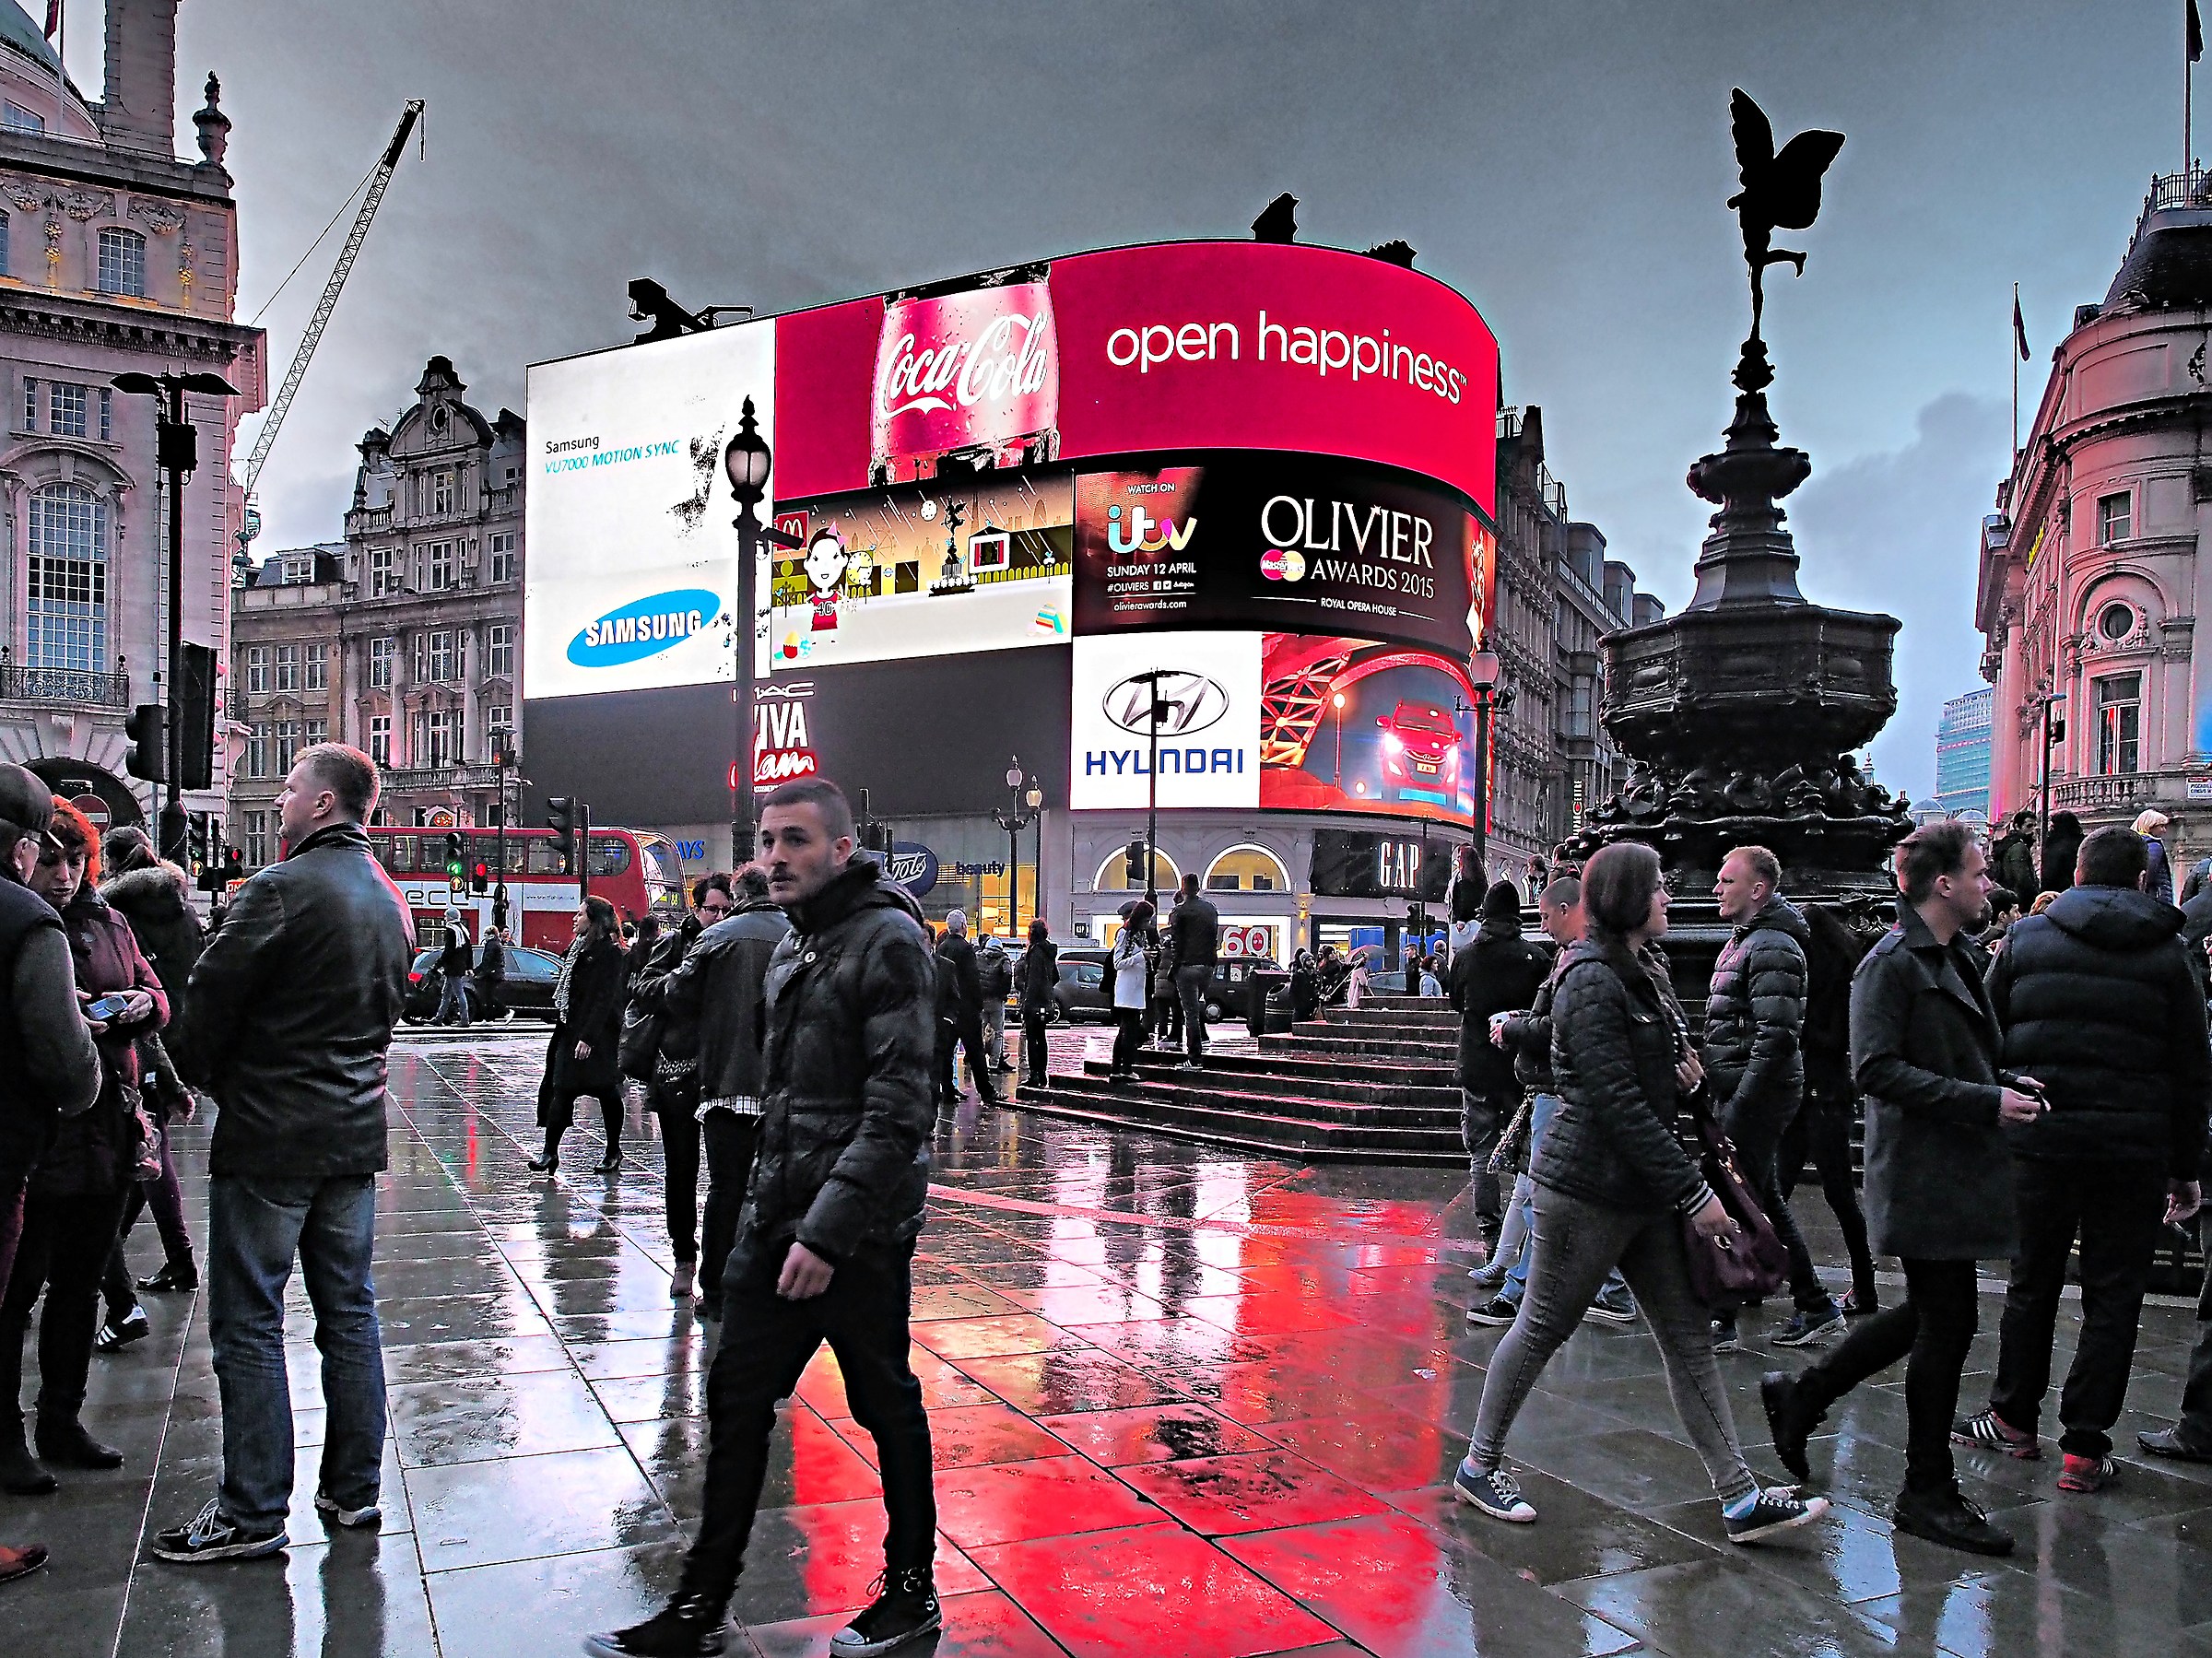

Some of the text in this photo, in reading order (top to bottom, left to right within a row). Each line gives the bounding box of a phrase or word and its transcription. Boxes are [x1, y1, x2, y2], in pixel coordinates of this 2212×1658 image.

[1106, 321, 1240, 373] open
[879, 312, 1049, 420] Coca-Cola
[545, 440, 680, 474] VU7000 MOTION SYNC
[546, 436, 600, 453] Samsung
[1127, 483, 1175, 494] WATCH ON
[1108, 505, 1197, 553] itv
[1261, 495, 1434, 570] OLIVIER
[1107, 562, 1196, 578] SUNDAY 12 APRIL
[1311, 558, 1434, 599] AWARDS 2015
[1107, 582, 1149, 593] #OLIVIERS
[817, 601, 834, 616] 40
[1113, 599, 1187, 612] olivierawards.com
[1321, 597, 1397, 617] ROYAL OPERA HOUSE
[584, 609, 703, 647] SAMSUNG
[753, 701, 808, 750] IVA
[1086, 748, 1244, 776] HYUNDAI
[956, 861, 1006, 878] beauty
[1380, 841, 1420, 889] GAP
[1223, 926, 1269, 956] 60
